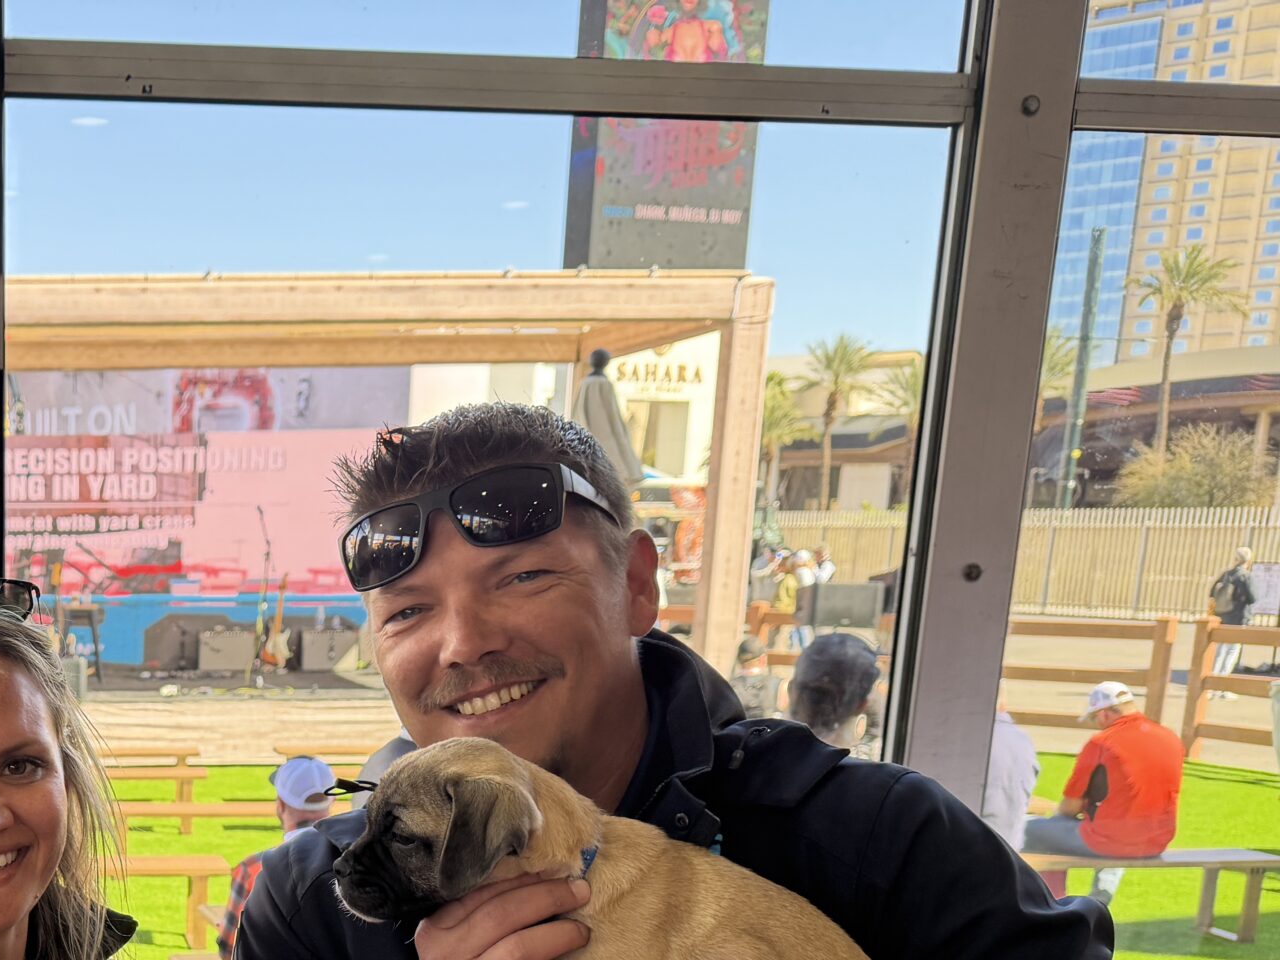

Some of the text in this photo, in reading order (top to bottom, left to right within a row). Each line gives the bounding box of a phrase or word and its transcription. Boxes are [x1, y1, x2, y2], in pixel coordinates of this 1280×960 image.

[616, 362, 703, 383] SAHARA
[87, 403, 137, 436] ON
[122, 446, 287, 475] POSITIONING
[51, 474, 80, 500] IN
[86, 473, 157, 501] YARD
[55, 514, 96, 532] with
[98, 513, 140, 533] yard
